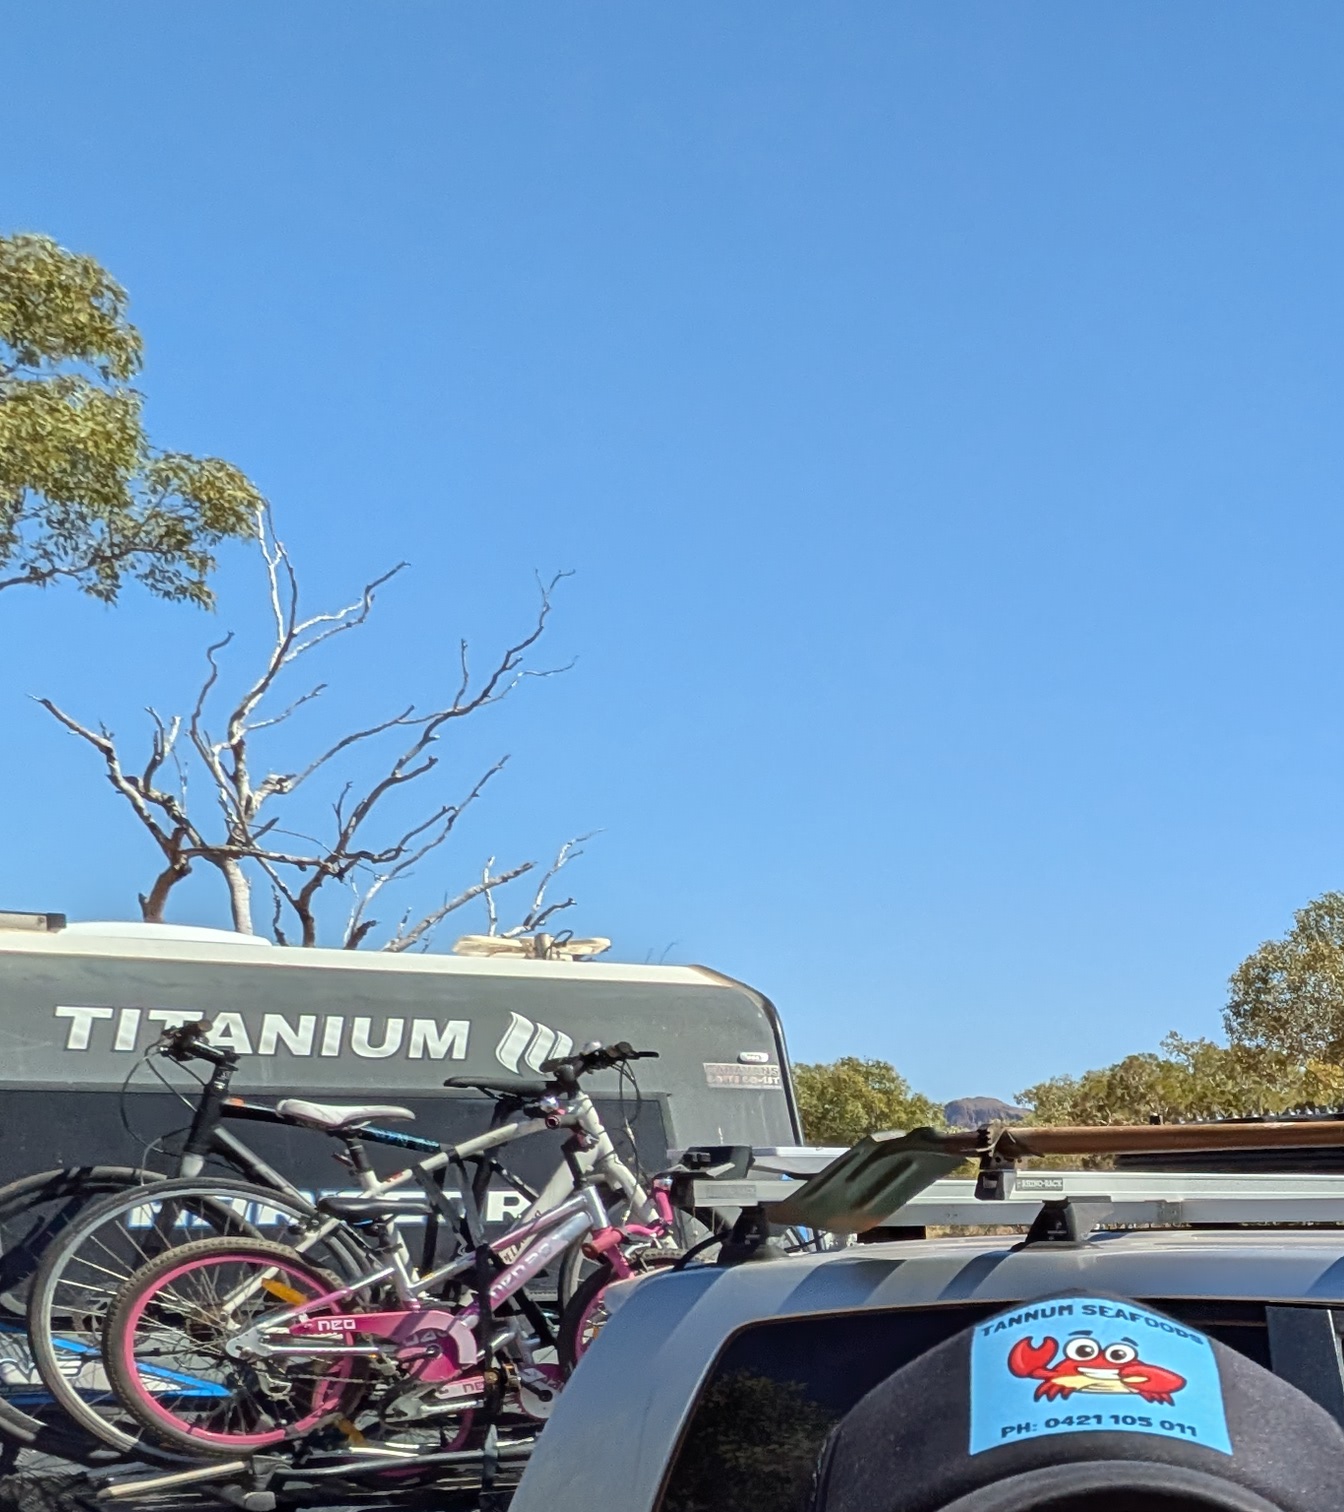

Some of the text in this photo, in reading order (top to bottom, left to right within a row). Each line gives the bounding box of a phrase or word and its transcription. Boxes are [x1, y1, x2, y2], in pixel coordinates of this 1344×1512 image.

[54, 1005, 471, 1060] TITANIUM
[318, 1318, 355, 1331] neo
[981, 1304, 1204, 1346] TANNUM SEAFOODS
[1000, 1414, 1197, 1439] PH: 0421 105 011
